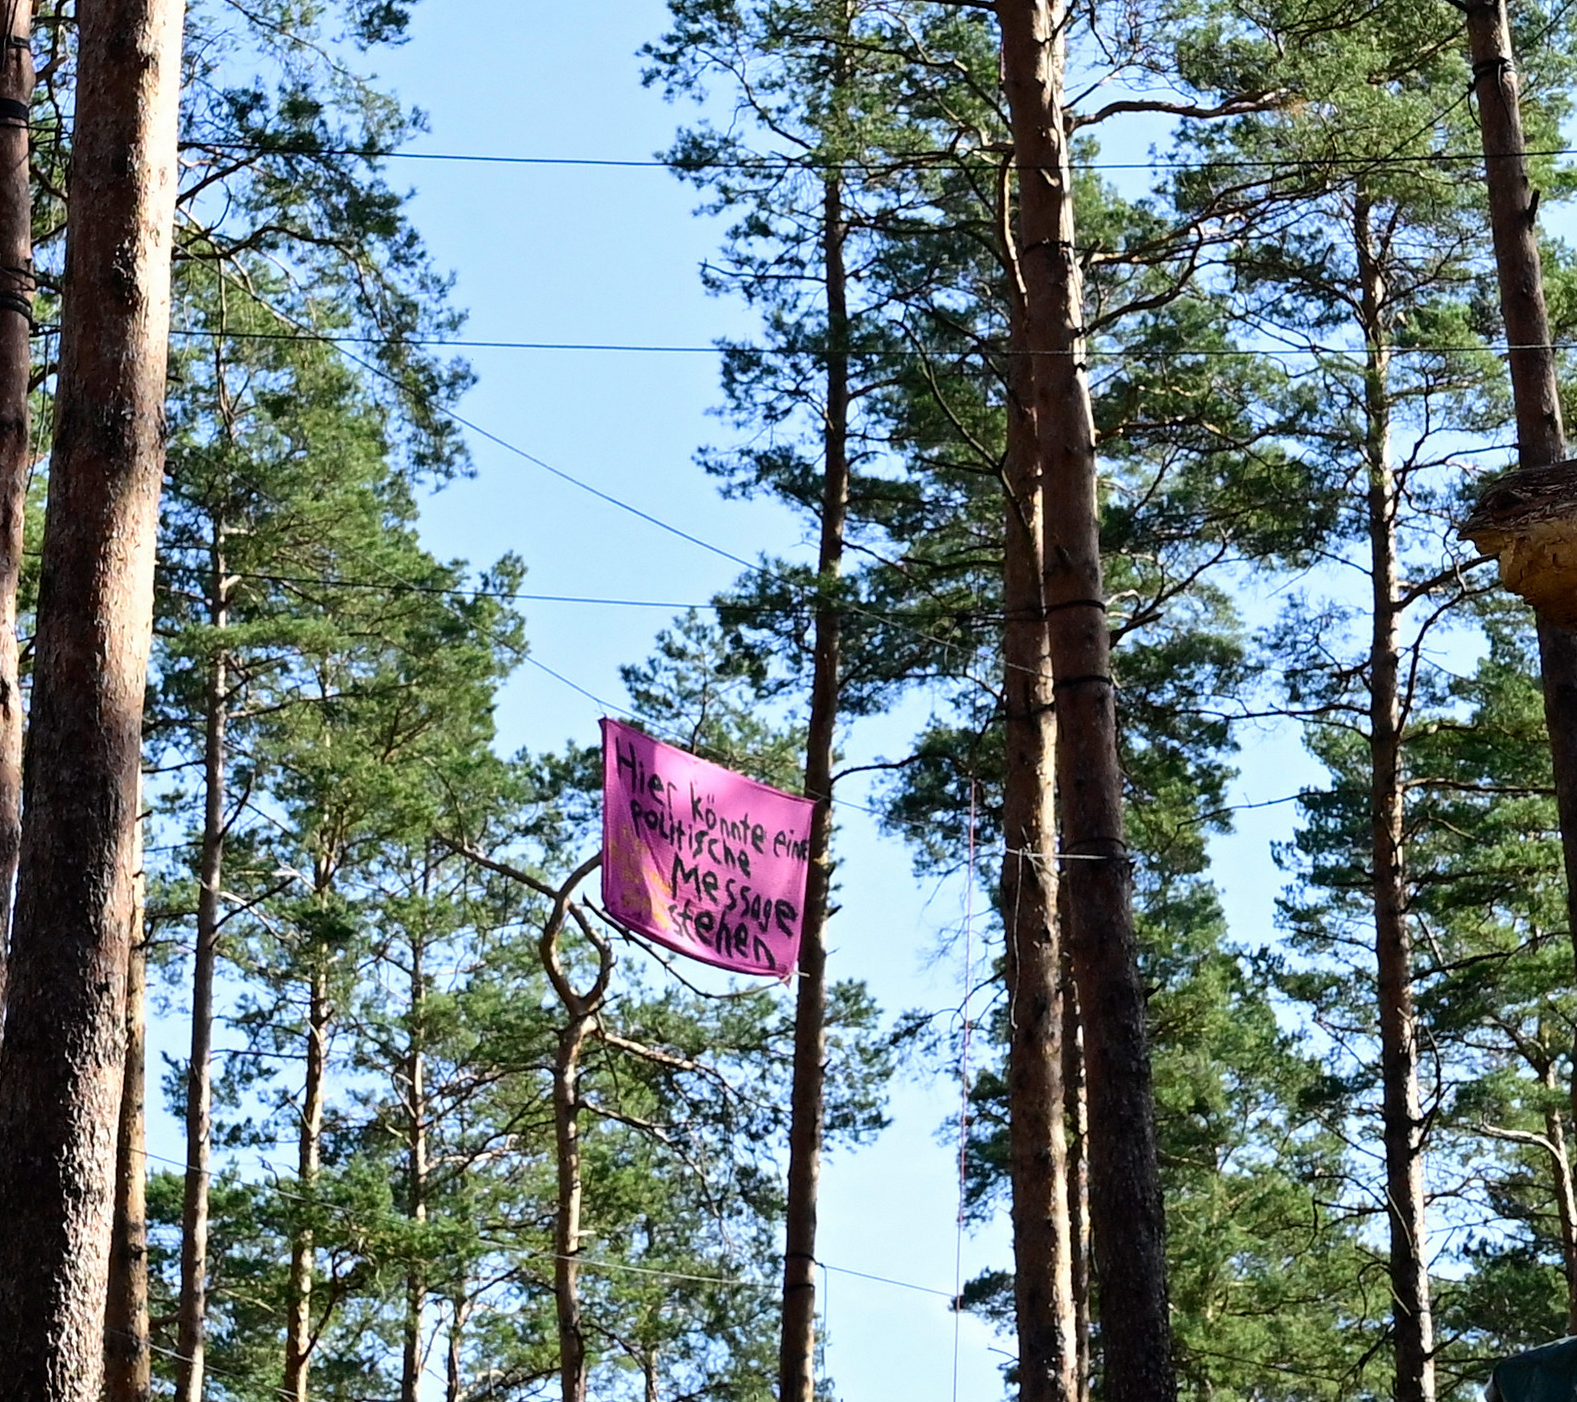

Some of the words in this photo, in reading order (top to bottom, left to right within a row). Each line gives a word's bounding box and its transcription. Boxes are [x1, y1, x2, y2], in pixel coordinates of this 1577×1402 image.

[616, 737, 677, 813] Hier
[690, 781, 767, 853] könnte
[671, 854, 798, 936] Message
